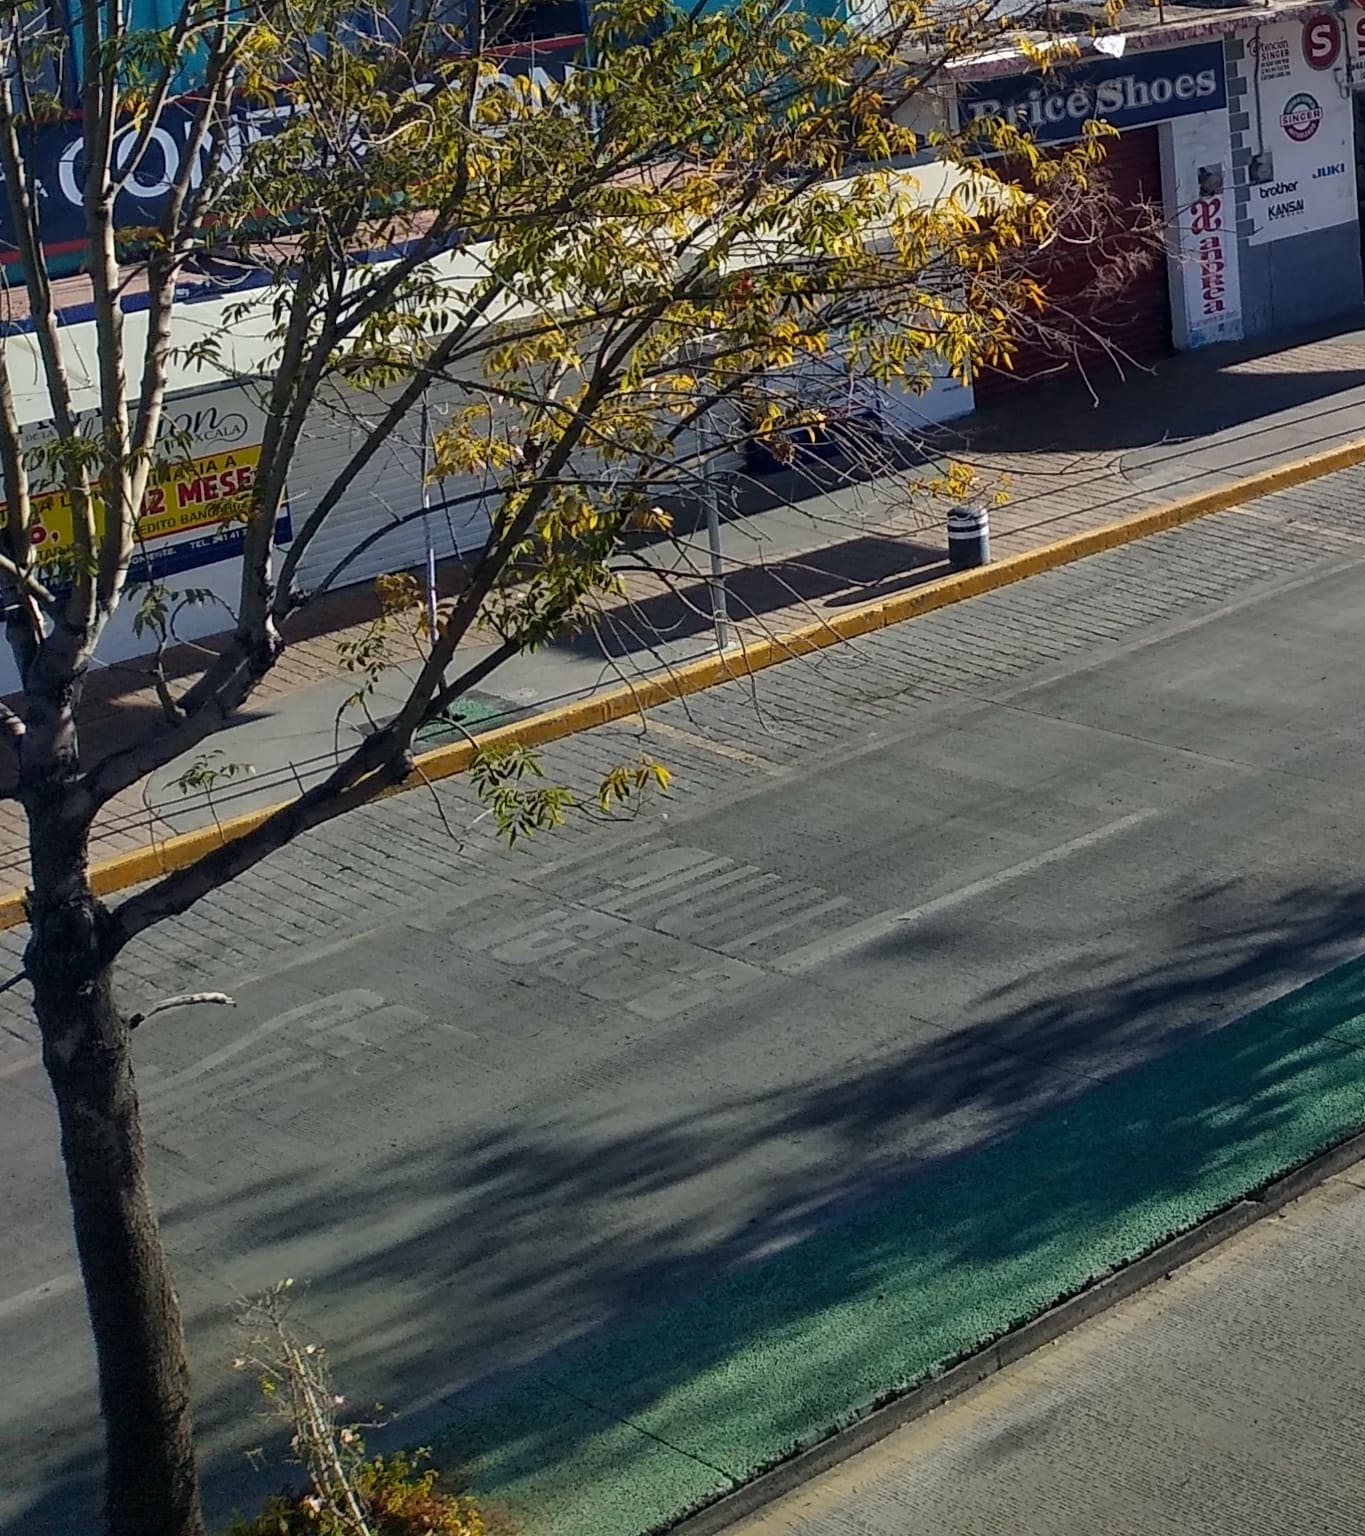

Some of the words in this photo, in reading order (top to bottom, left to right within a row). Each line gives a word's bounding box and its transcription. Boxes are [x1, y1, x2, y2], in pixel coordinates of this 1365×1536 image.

[1311, 24, 1332, 57] S
[1097, 69, 1218, 114] Shoes
[1282, 109, 1322, 125] SINGER
[1312, 163, 1345, 180] JUKI
[1260, 180, 1299, 199] brother
[1267, 198, 1305, 218] KANSAI
[177, 466, 258, 508] MESE
